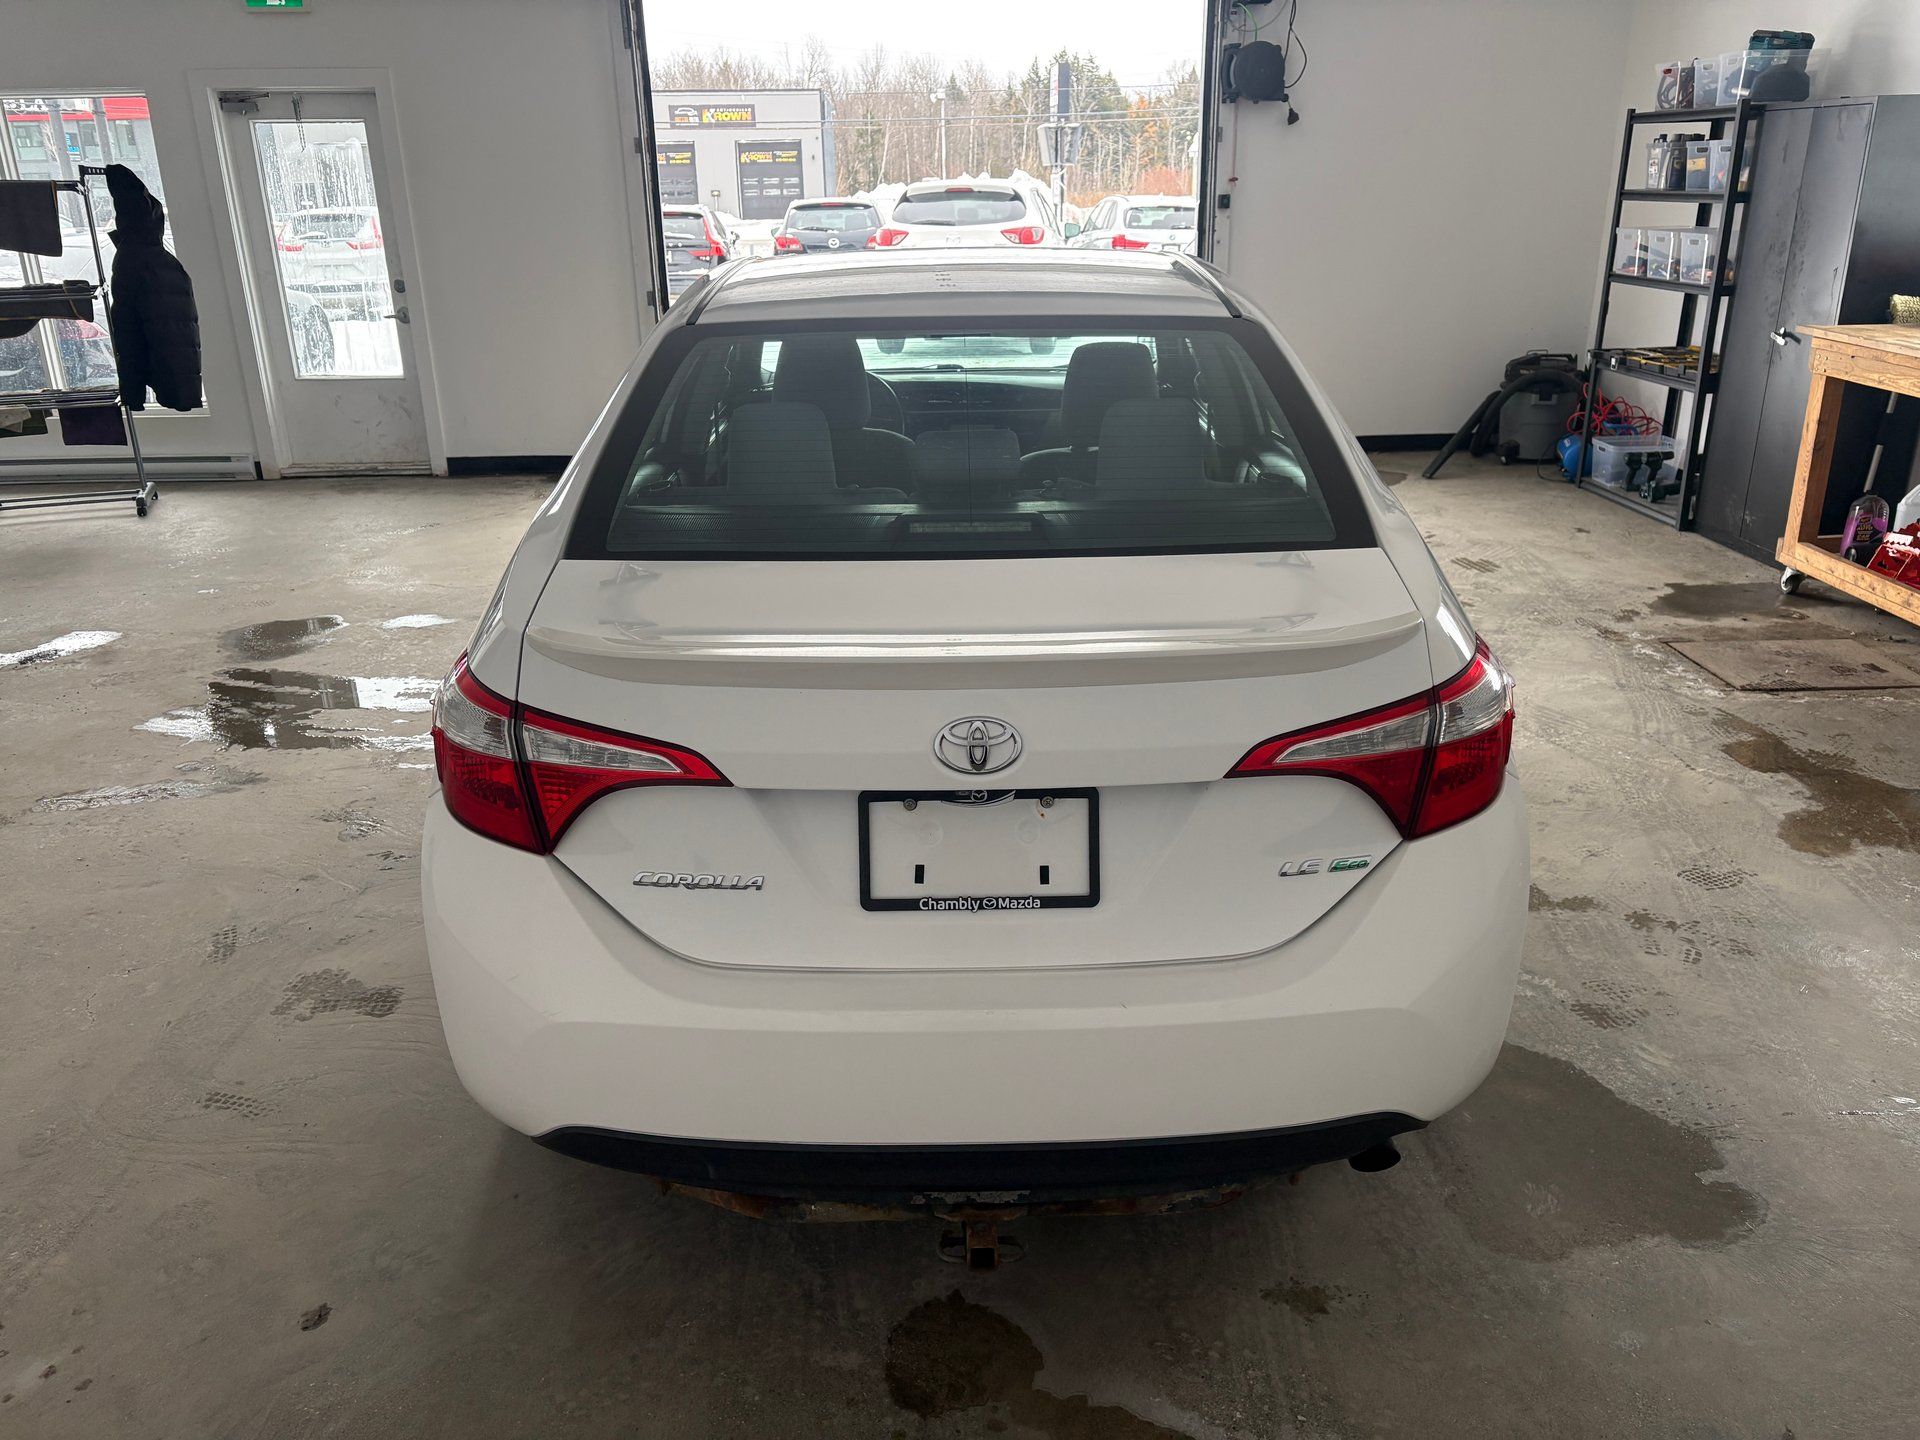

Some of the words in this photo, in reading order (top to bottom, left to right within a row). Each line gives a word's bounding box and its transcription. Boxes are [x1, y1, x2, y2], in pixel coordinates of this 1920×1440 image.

[702, 108, 752, 123] KROWN
[1279, 858, 1323, 877] LE
[1328, 856, 1371, 873] Eco
[632, 871, 764, 890] COROLLA
[919, 897, 980, 913] Chambly
[998, 896, 1041, 910] Mazda
